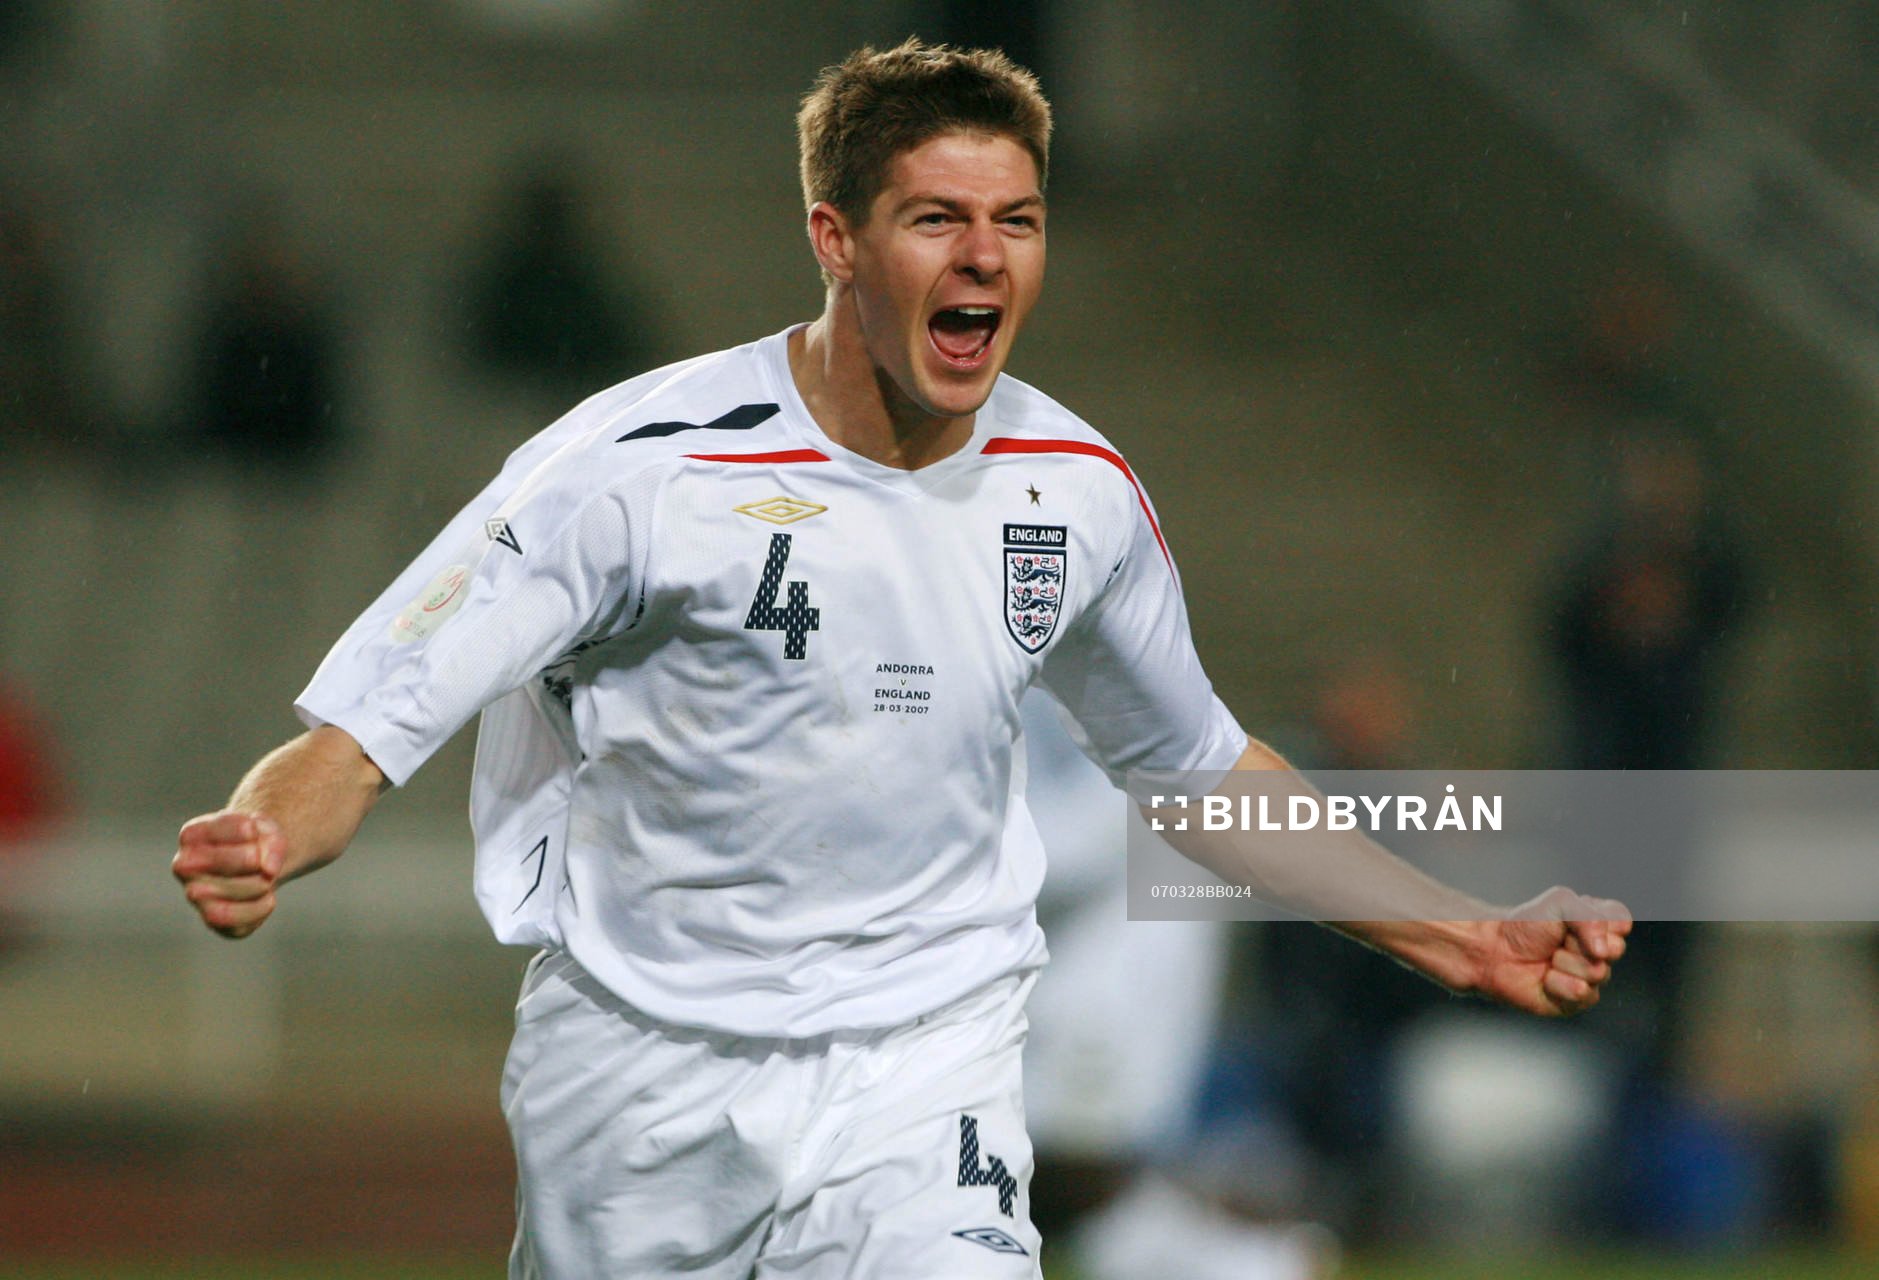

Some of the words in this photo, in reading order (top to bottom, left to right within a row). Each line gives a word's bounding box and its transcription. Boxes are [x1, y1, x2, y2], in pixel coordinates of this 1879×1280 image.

[1008, 528, 1063, 543] ENGLAND
[744, 533, 820, 660] 4
[875, 663, 935, 676] ANDORRA
[874, 688, 931, 701] ENGLAND
[957, 1113, 1018, 1219] 4
